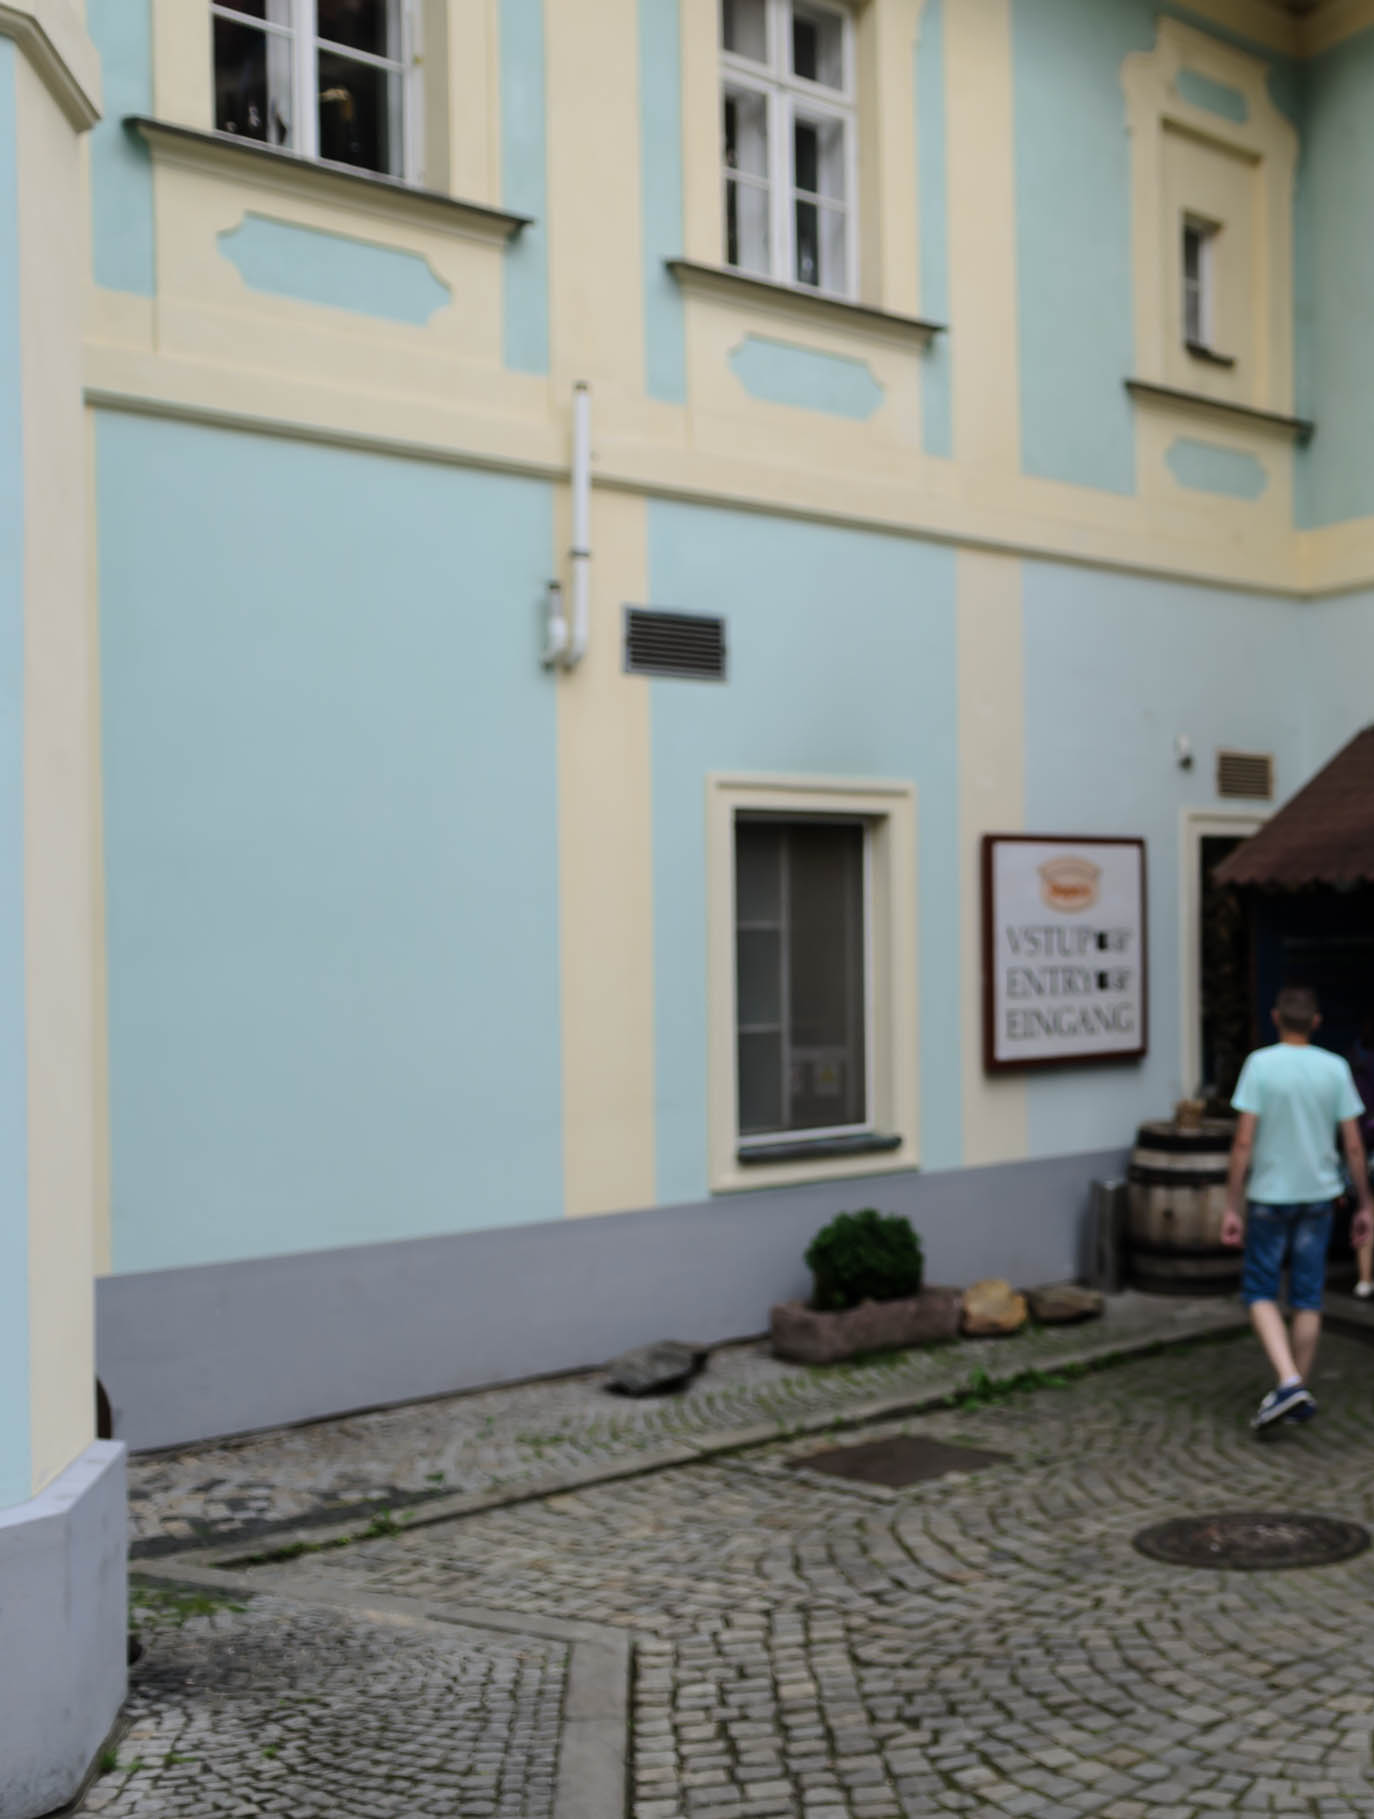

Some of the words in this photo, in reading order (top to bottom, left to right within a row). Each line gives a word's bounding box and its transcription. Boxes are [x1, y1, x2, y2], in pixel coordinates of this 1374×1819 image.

[1005, 926, 1091, 956] VSTUP
[1006, 966, 1092, 998] ENTRY
[1006, 1004, 1134, 1039] EINGANG
